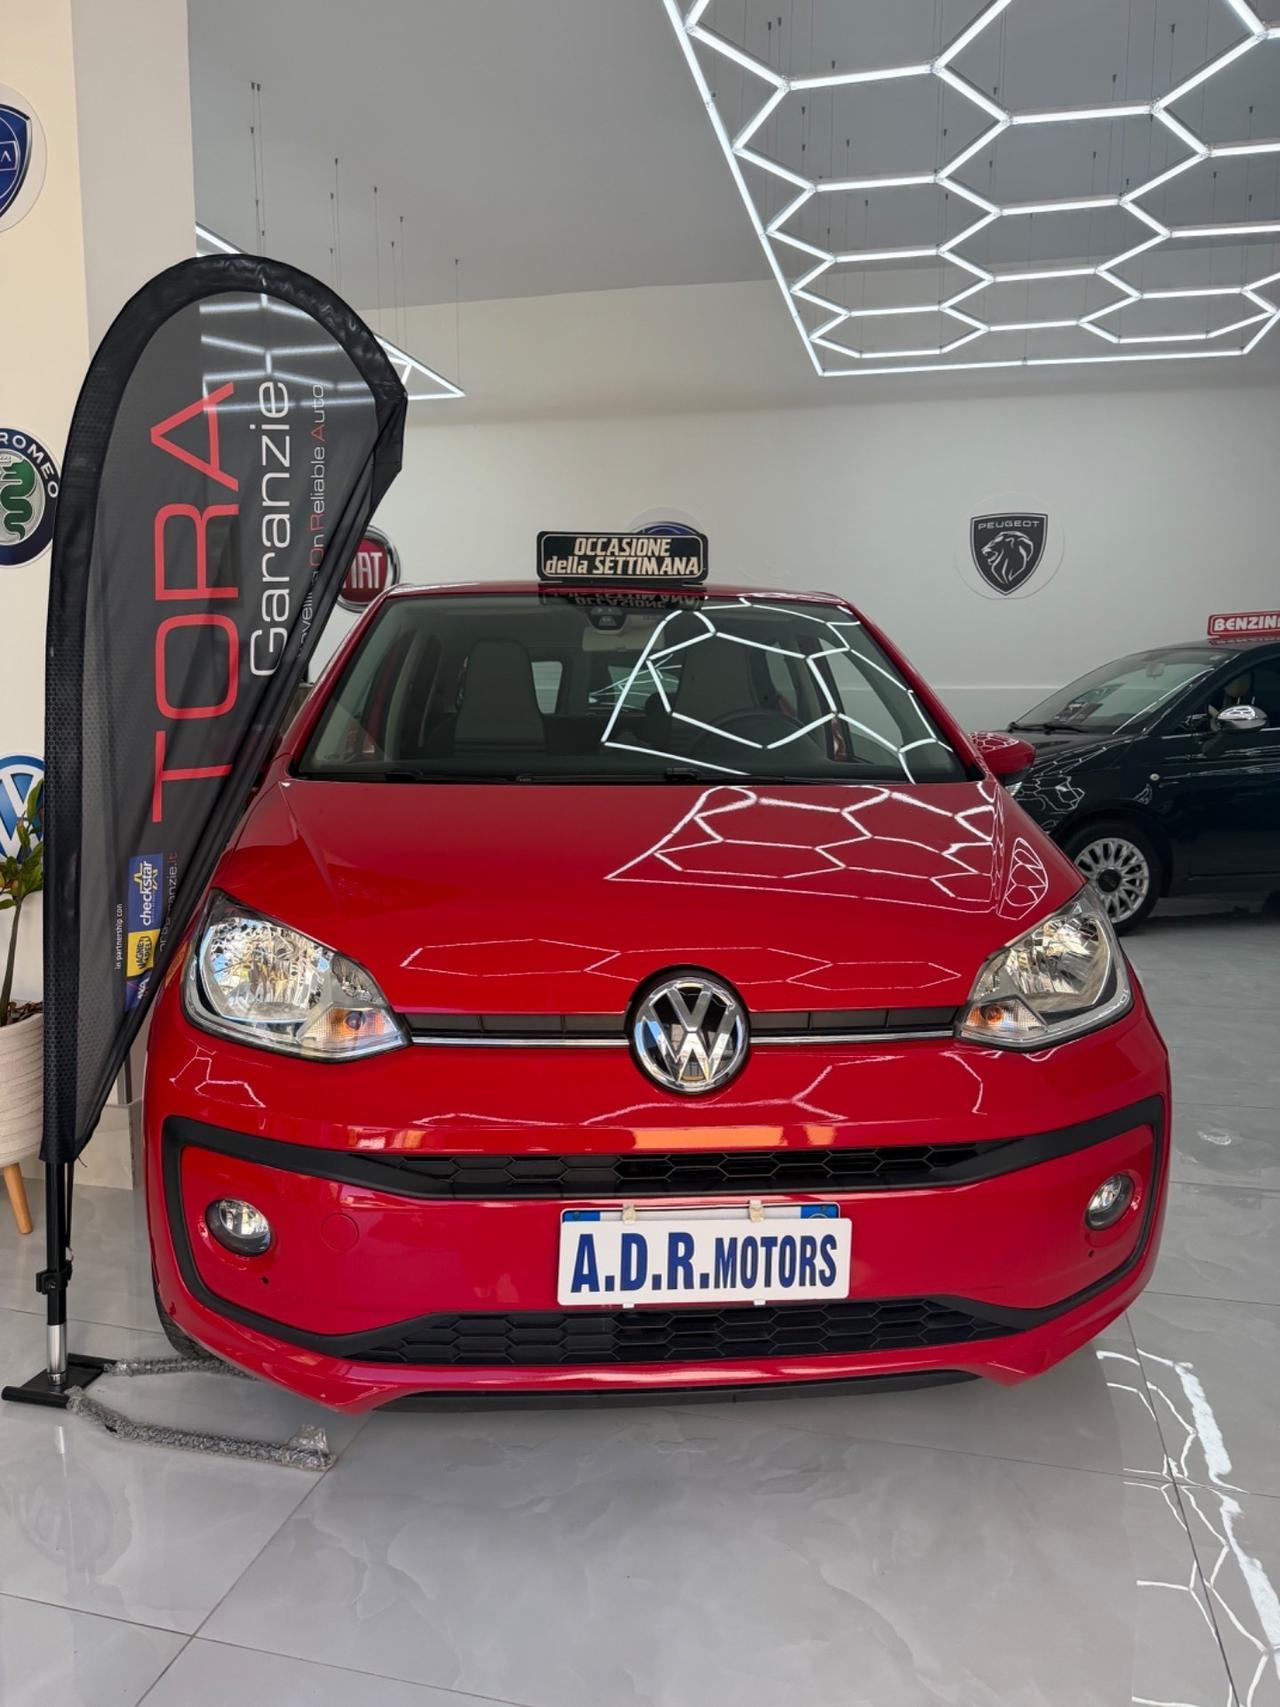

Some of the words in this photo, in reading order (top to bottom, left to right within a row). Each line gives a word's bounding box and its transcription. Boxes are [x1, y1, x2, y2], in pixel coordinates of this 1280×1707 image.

[310, 384, 326, 442] Auto
[0, 432, 59, 498] ROMEO
[310, 446, 325, 531] Reliable
[250, 381, 291, 677] Garanzie
[978, 520, 1040, 530] PEUGEOT
[310, 534, 325, 567] On
[545, 556, 588, 575] della
[592, 556, 699, 576] SETTIMANA
[574, 537, 671, 557] OCCASIONE
[343, 552, 382, 589] IAT
[150, 382, 239, 823] TORA
[1213, 615, 1280, 632] BENZIN
[139, 860, 153, 926] checkstar
[115, 919, 123, 960] partnership
